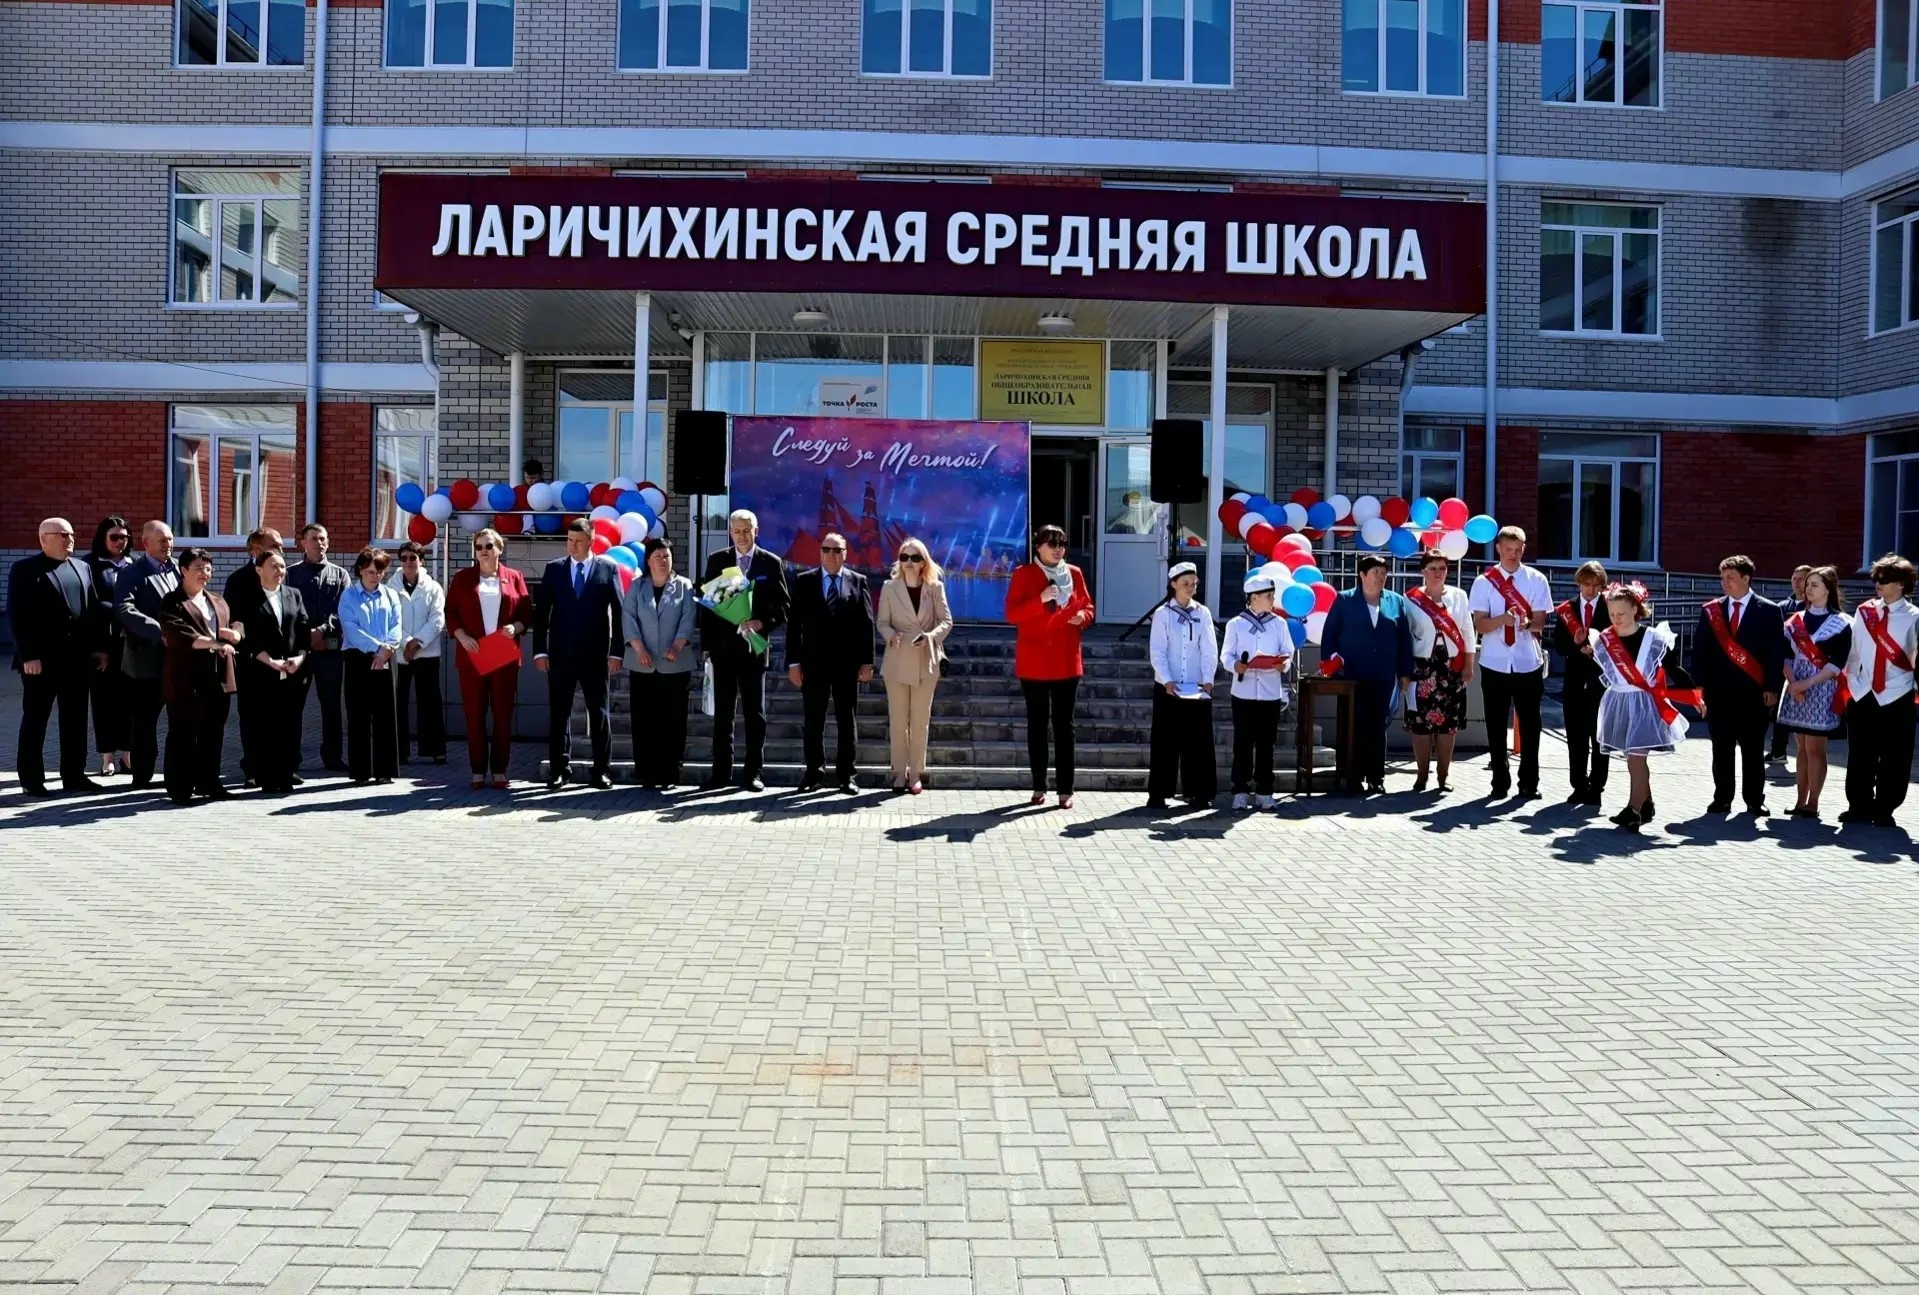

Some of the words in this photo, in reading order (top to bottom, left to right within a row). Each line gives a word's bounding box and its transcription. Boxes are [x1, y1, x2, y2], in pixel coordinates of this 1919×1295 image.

[432, 204, 927, 263] ЛАРИЧИХИНСКАЯ
[946, 211, 1206, 276] СРЕДНЯЯ
[1225, 221, 1428, 281] ШКОЛА
[1007, 390, 1076, 405] ШКОЛА
[772, 426, 852, 464] Следуй
[845, 448, 876, 468] за
[879, 441, 1000, 475] Мечтой!
